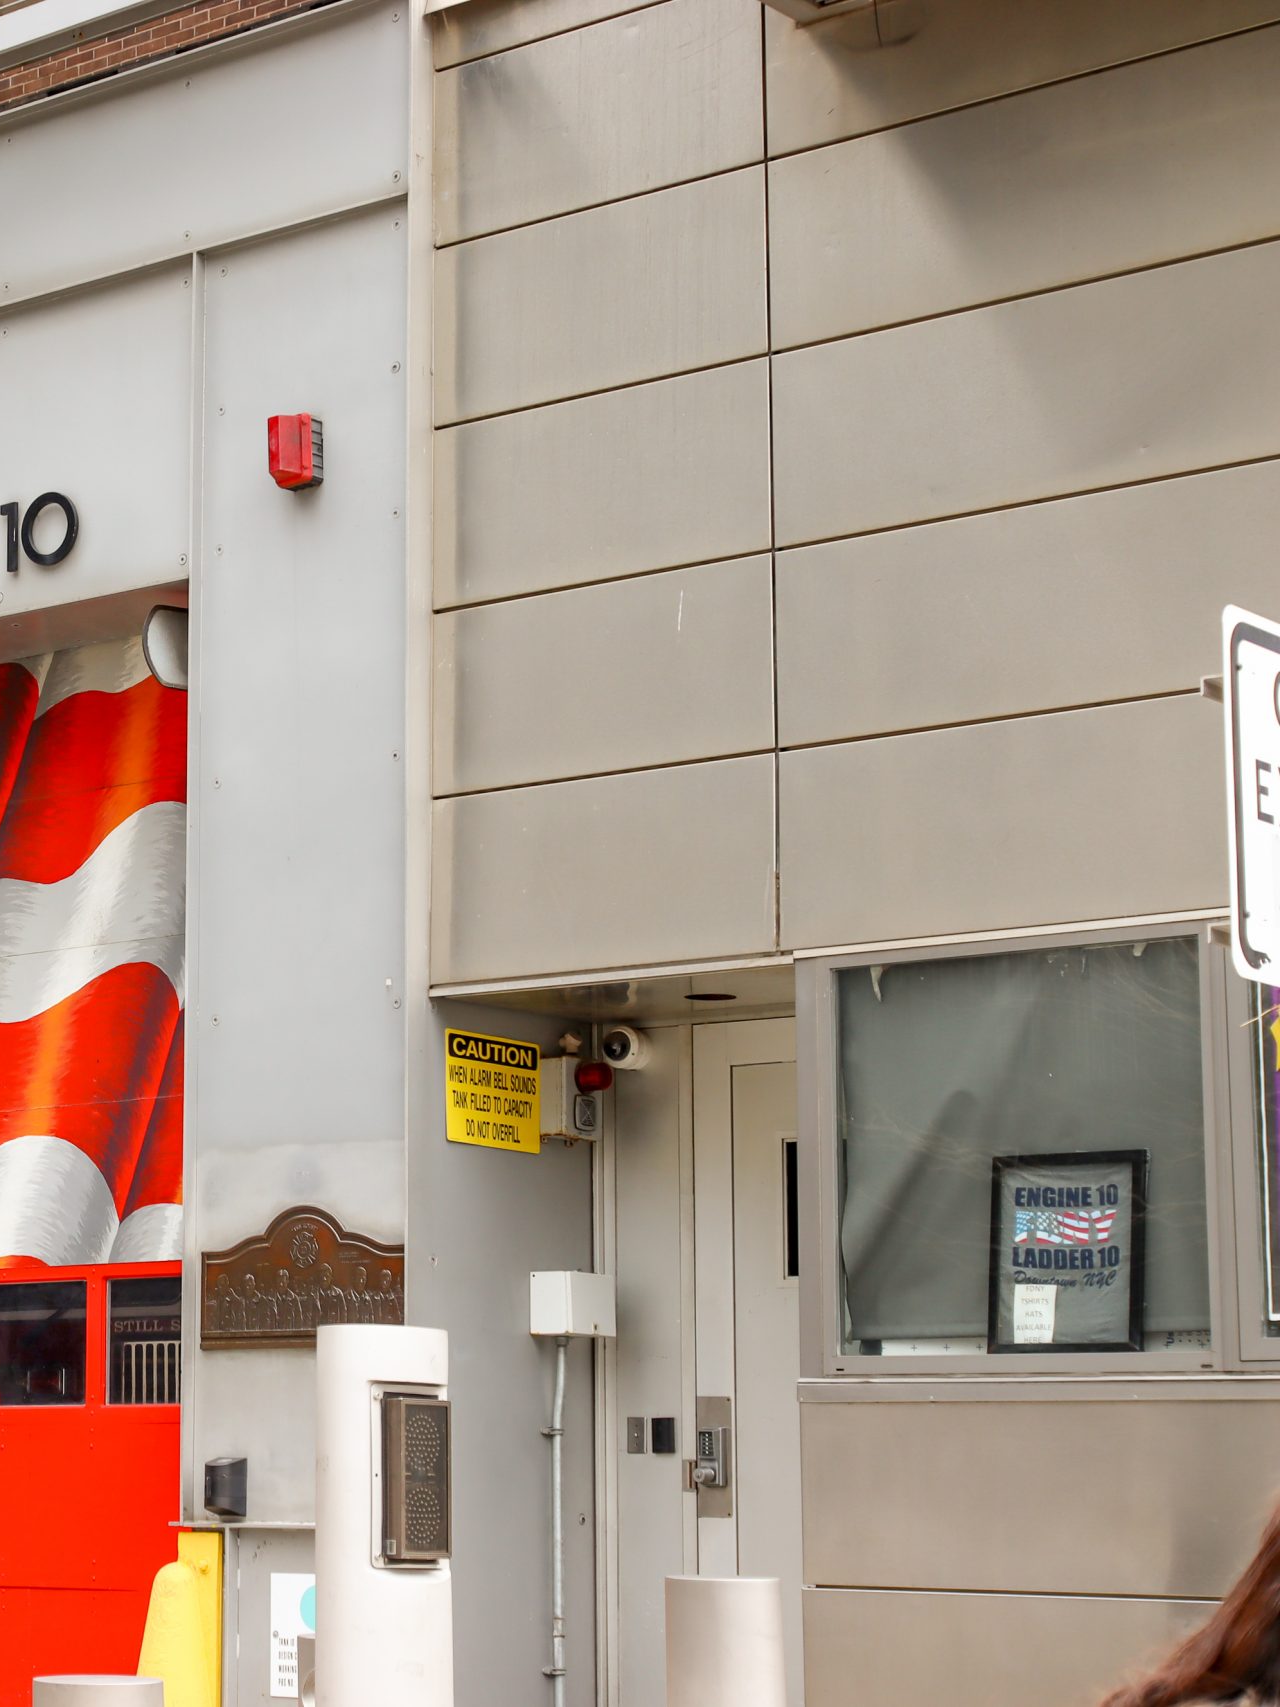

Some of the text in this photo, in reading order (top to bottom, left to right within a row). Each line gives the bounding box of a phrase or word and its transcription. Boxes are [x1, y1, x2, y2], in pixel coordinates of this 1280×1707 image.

[0, 491, 79, 573] 10
[1255, 758, 1280, 828] E
[452, 1037, 533, 1067] CAUTION
[449, 1064, 536, 1095] WHEN ALARM BELL SOUNDS
[452, 1090, 533, 1119] TANK FILLED TO CAPACITY
[466, 1119, 520, 1143] DO NOT OVERFILL
[1014, 1184, 1119, 1208] ENGINE 10
[1014, 1209, 1117, 1245] FDNY
[1012, 1245, 1120, 1270] LADDER 10
[1014, 1269, 1117, 1288] Downtown NYC
[114, 1319, 163, 1333] STILL
